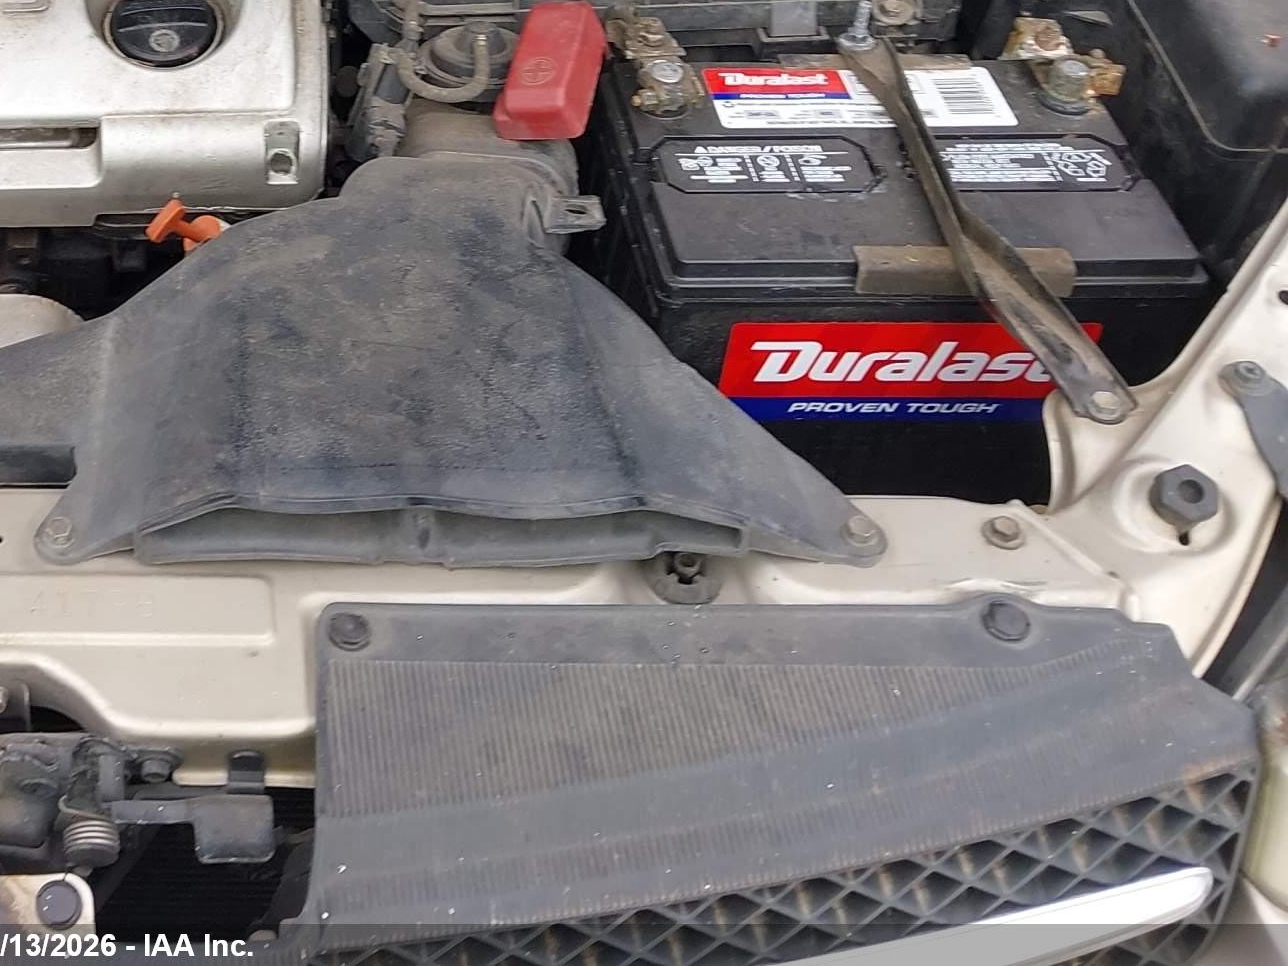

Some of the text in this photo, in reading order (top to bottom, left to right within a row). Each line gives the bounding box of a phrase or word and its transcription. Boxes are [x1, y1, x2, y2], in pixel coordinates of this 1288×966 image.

[718, 72, 829, 86] Duralast
[787, 402, 1002, 414] PROVEN TOUGH
